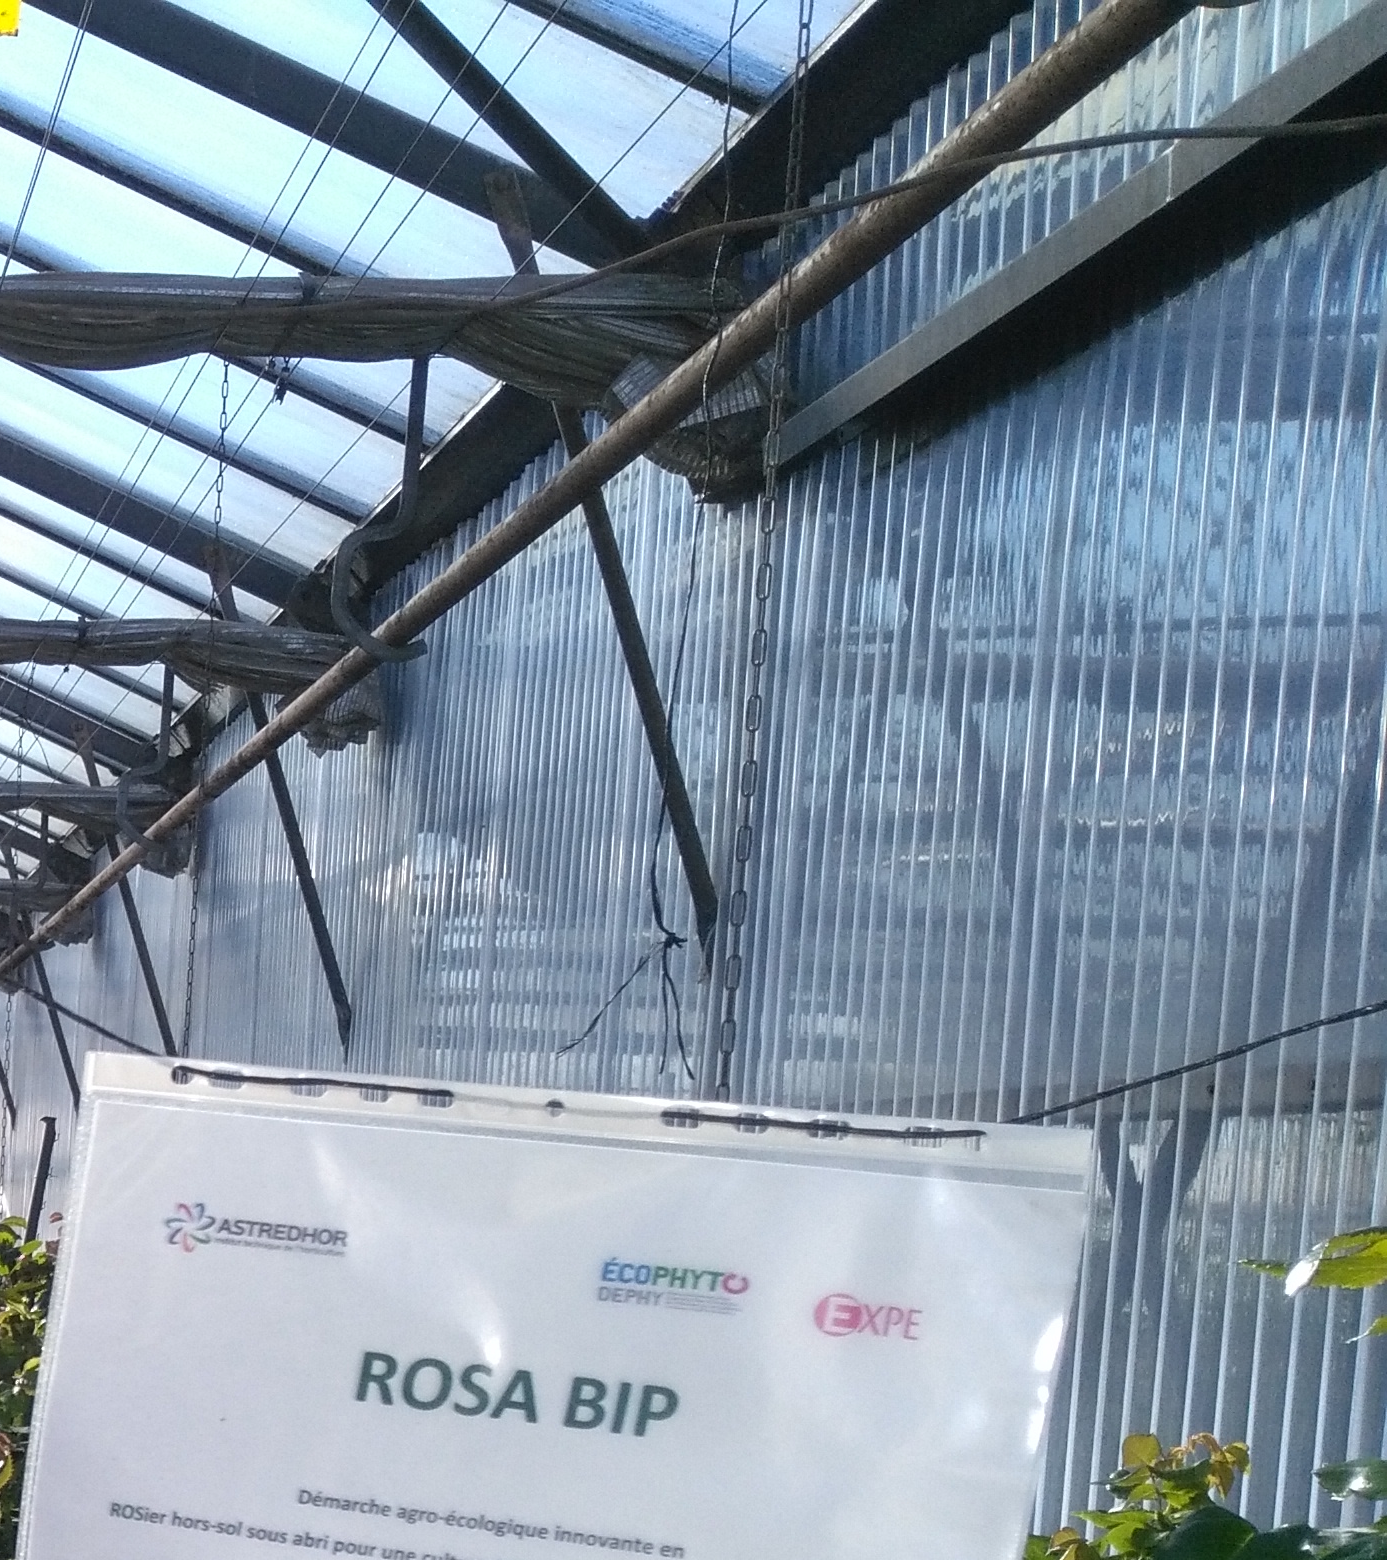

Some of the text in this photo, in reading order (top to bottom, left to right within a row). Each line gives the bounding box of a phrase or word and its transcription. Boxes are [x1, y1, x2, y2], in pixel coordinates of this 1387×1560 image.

[217, 1218, 348, 1247] ASTREDHOR
[598, 1286, 664, 1306] DEPHY
[601, 1257, 750, 1295] ÉCOPHYTO
[821, 1295, 923, 1341] EXPE
[355, 1351, 680, 1437] ROSA BIP
[109, 1502, 167, 1525] ROSier
[171, 1514, 243, 1537] hors-sol
[246, 1526, 287, 1545] sous
[292, 1531, 330, 1551] abri
[332, 1539, 377, 1560] pour
[297, 1489, 686, 1559] Démarche agro-écologique innovante en
